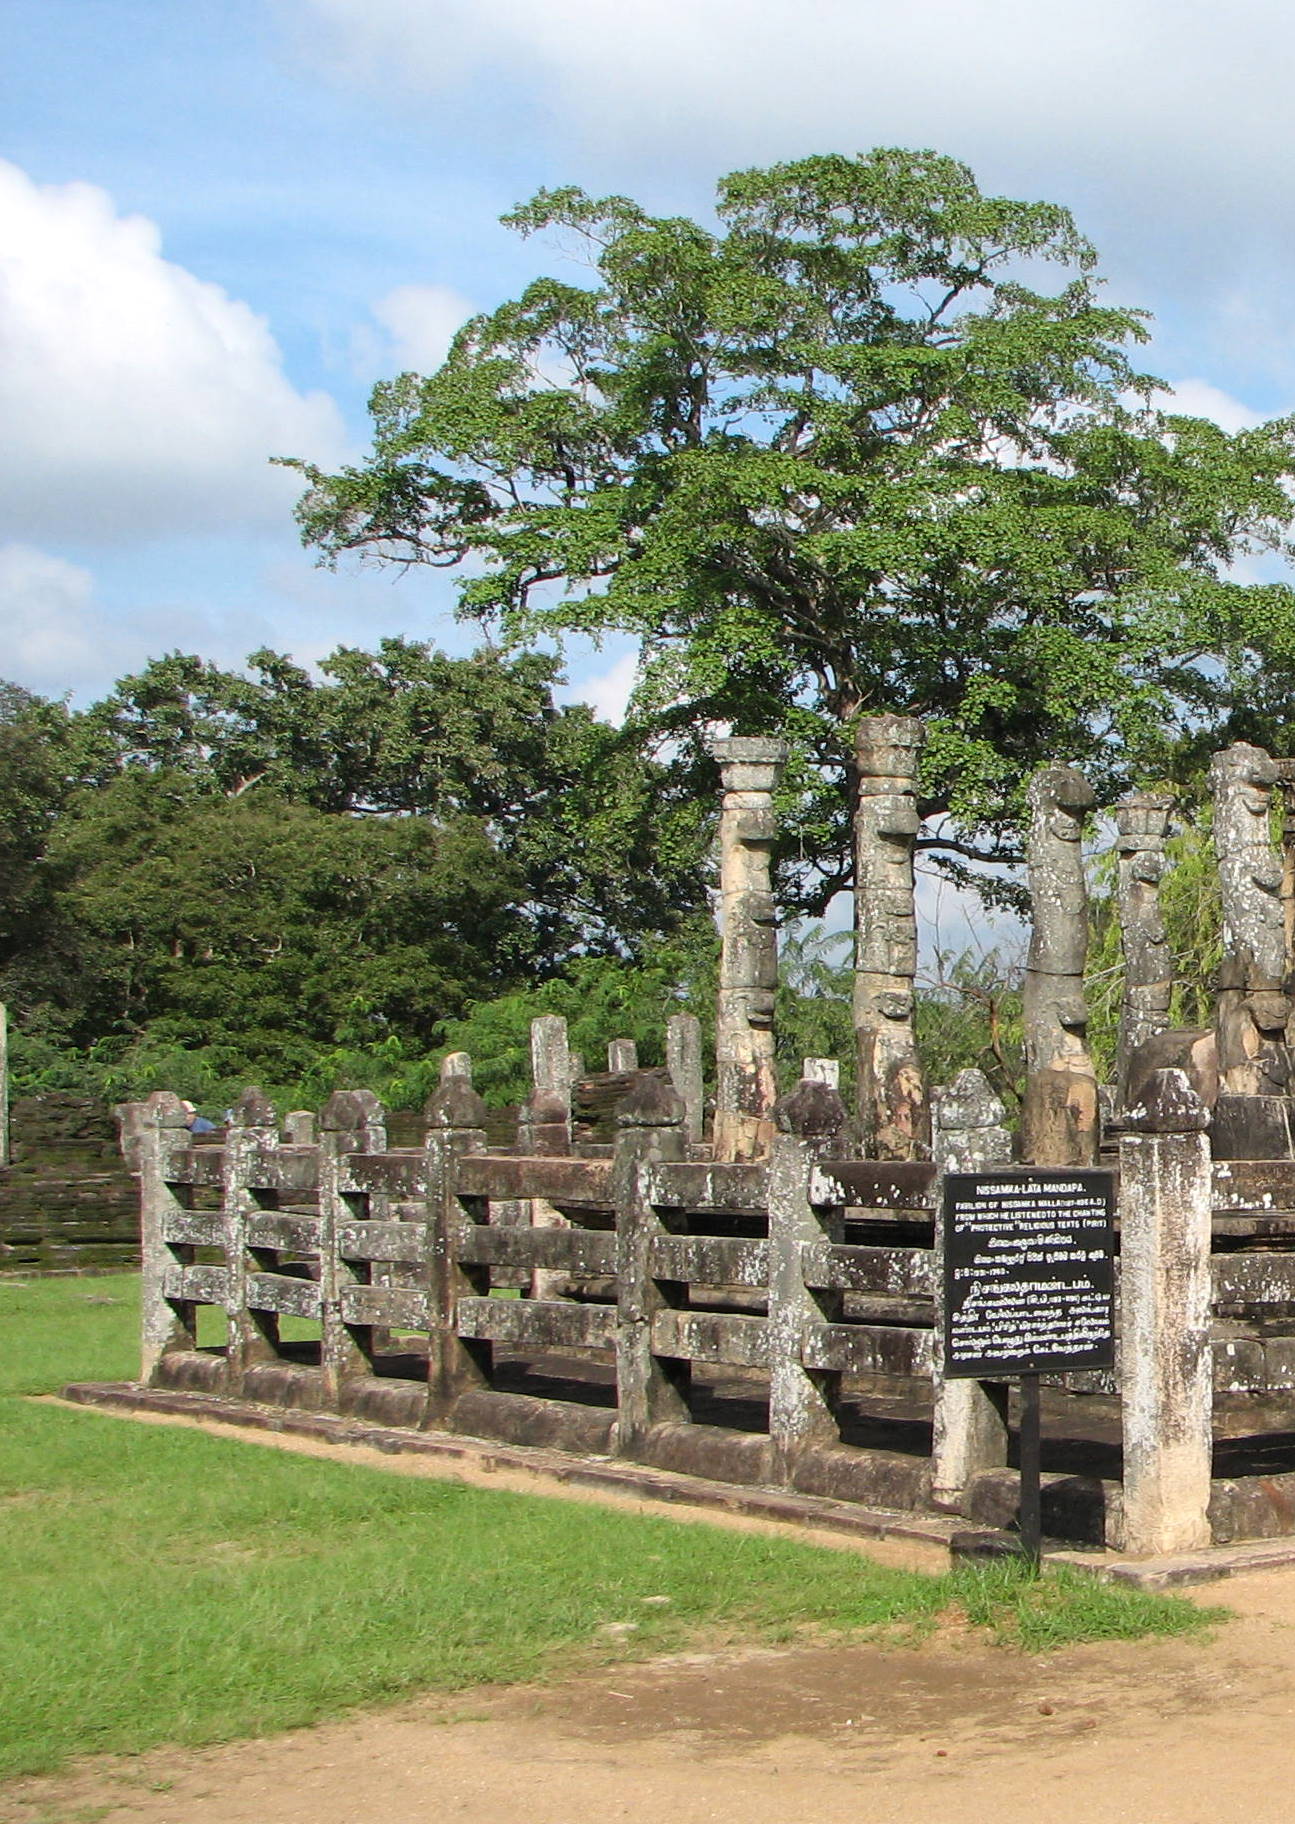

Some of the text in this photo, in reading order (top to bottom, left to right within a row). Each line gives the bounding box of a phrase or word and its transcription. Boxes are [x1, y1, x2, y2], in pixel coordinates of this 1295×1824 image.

[988, 1201, 999, 1209] OF
[955, 1213, 976, 1222] FROM
[977, 1212, 999, 1220] WHICH
[1000, 1211, 1010, 1220] HE
[1058, 1209, 1071, 1218] THE
[1072, 1207, 1106, 1217] CHANTING
[955, 1224, 965, 1233] OF
[1057, 1220, 1080, 1229] TEXTS
